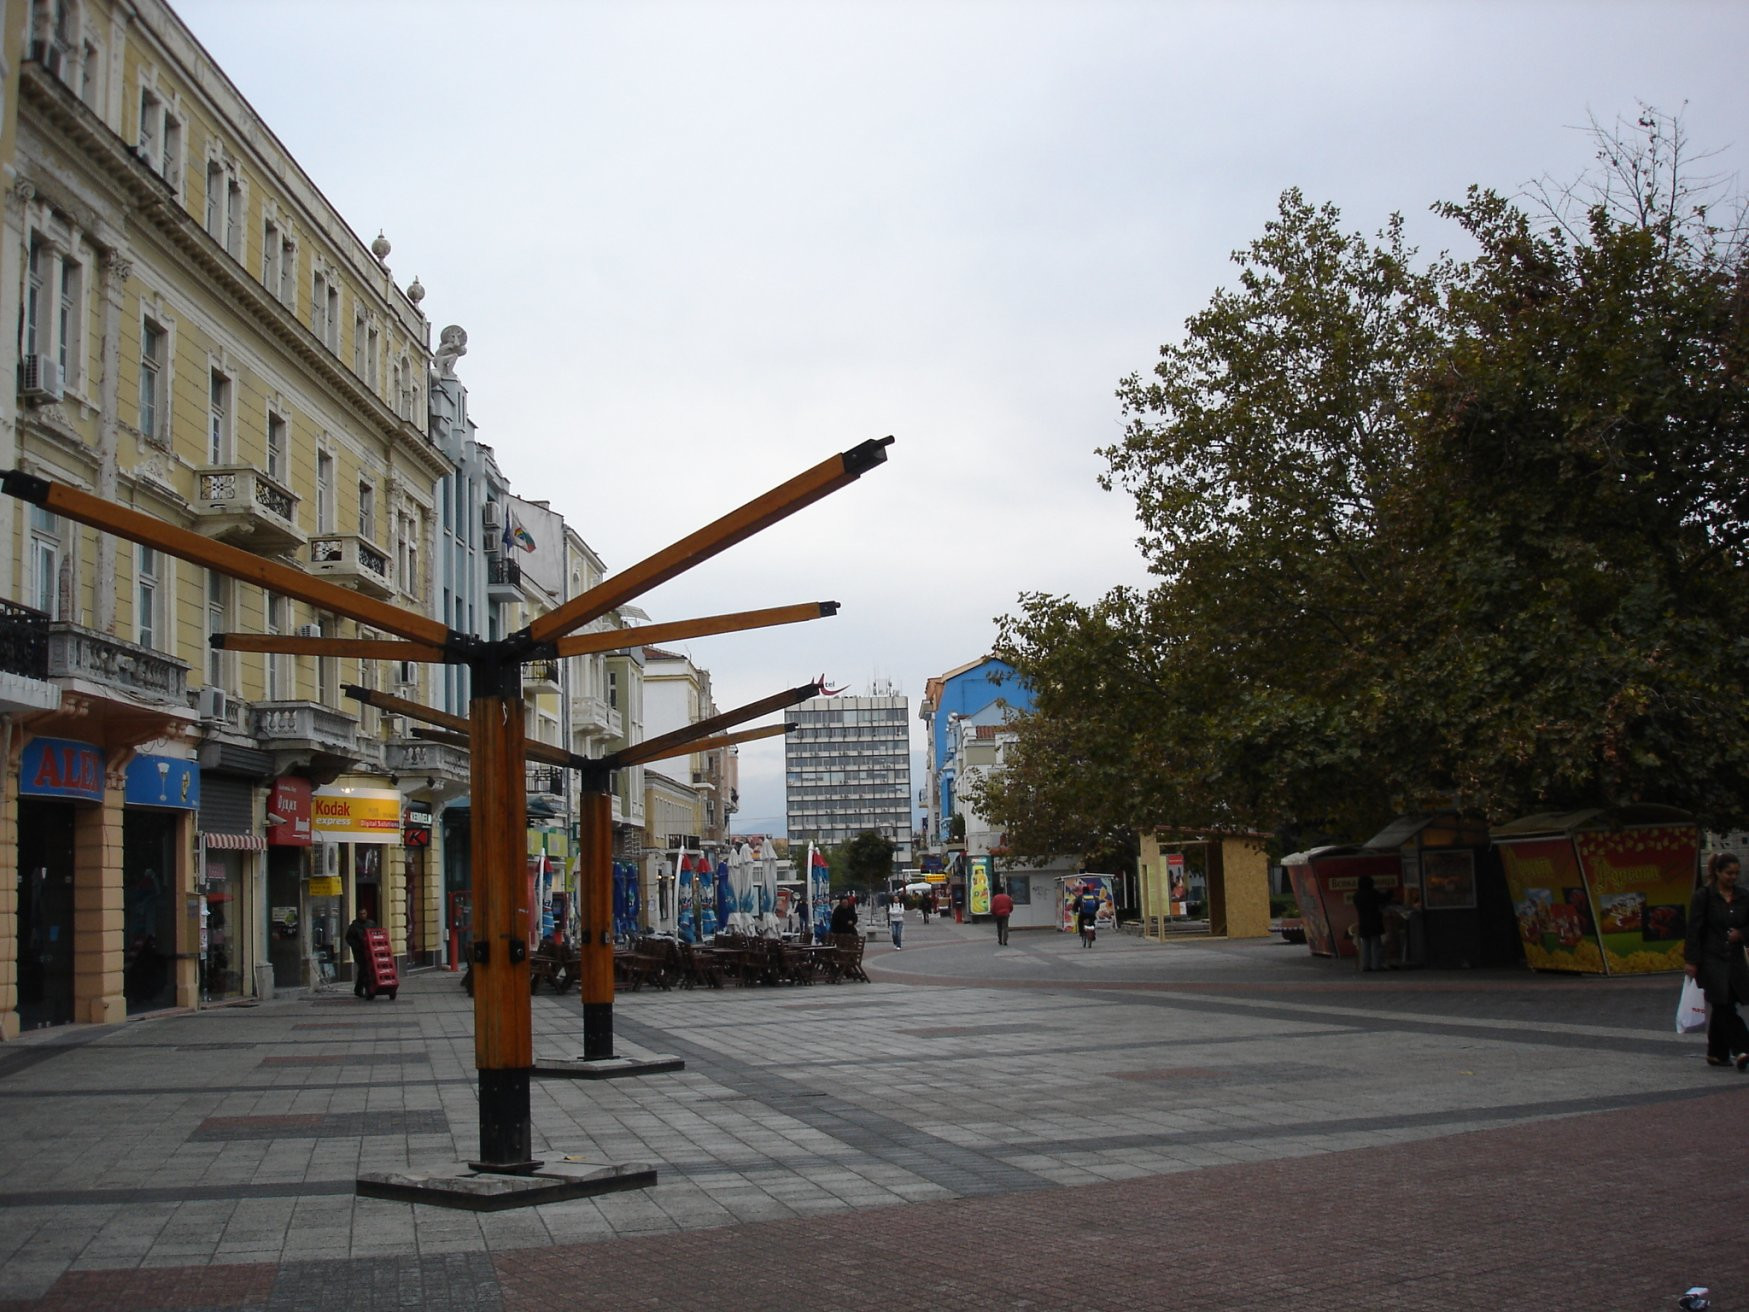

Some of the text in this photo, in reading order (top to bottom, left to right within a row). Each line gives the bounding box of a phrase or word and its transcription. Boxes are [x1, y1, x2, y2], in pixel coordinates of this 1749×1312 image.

[35, 745, 100, 793] ALEX
[315, 799, 351, 817] Kodak
[315, 817, 352, 826] express
[360, 819, 377, 828] Digital
